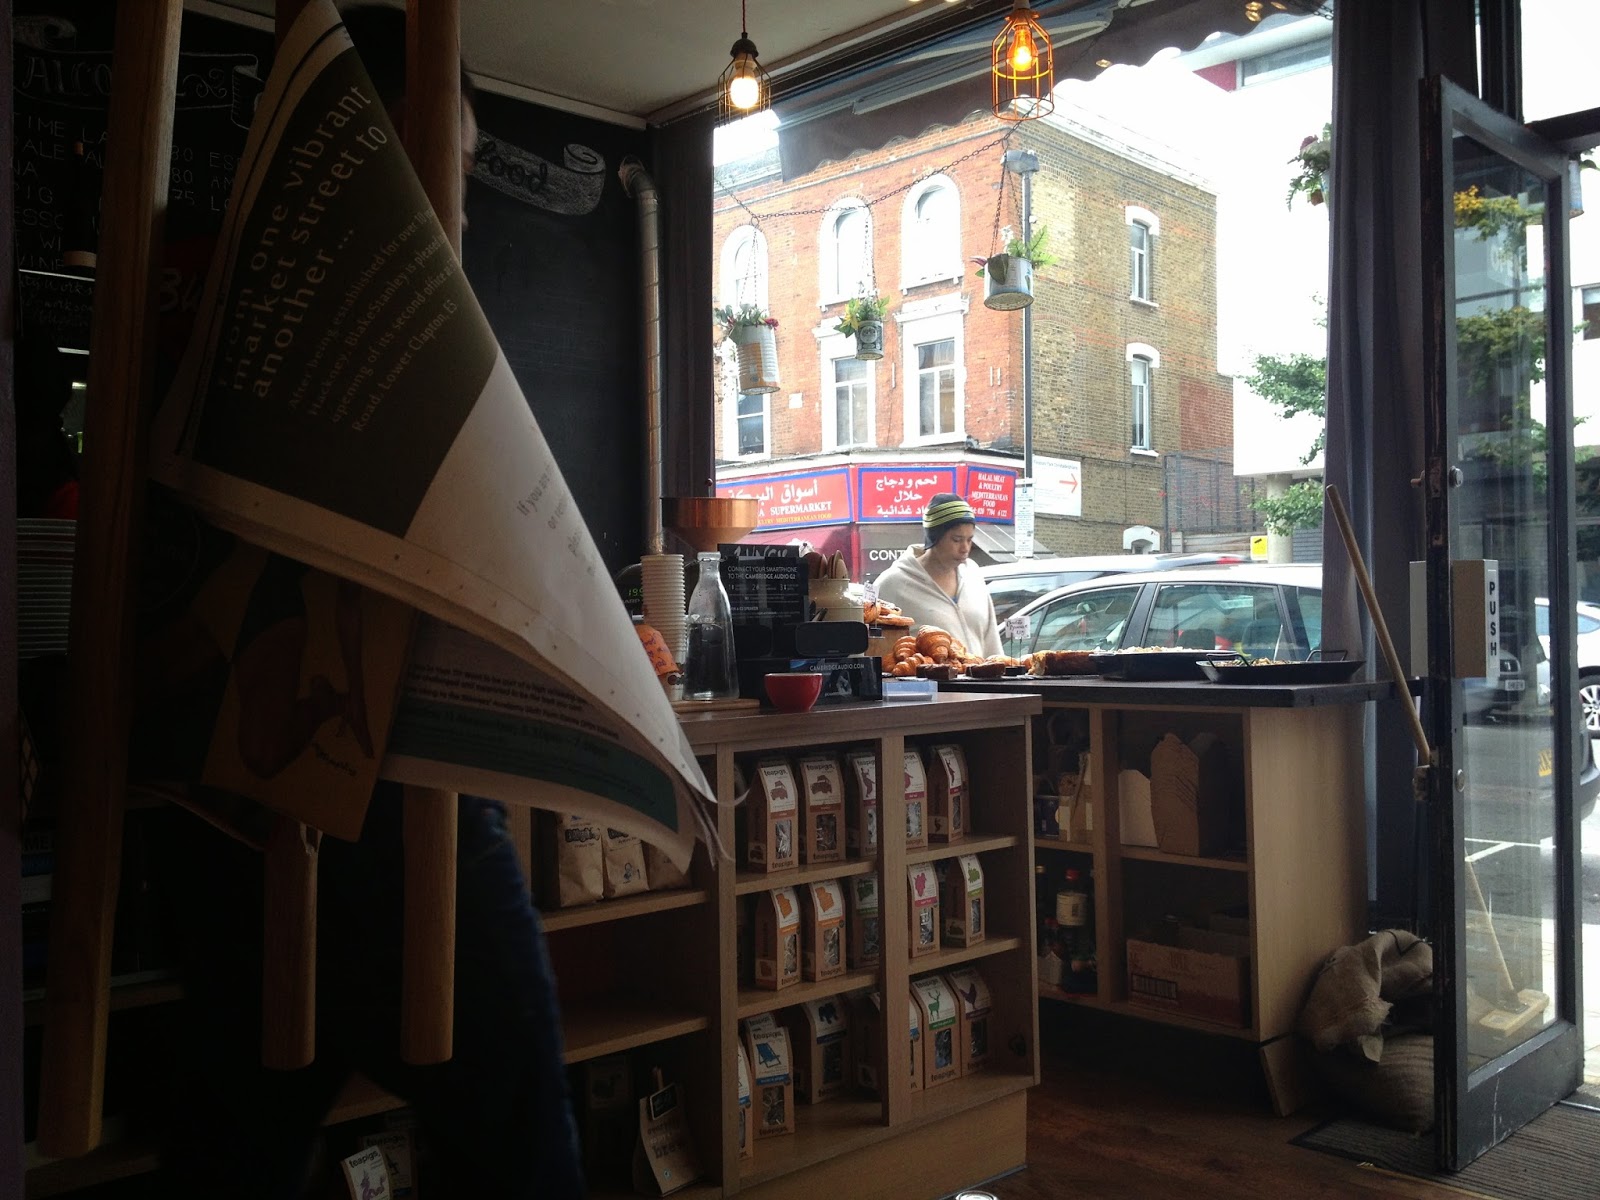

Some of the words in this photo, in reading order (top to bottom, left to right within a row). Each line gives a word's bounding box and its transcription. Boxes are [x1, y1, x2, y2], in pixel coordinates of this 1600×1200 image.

[251, 204, 289, 271] one
[283, 86, 371, 189] vibrant
[380, 238, 400, 257] for
[398, 221, 417, 242] over
[233, 256, 297, 391] market
[291, 150, 364, 245] street
[356, 126, 387, 151] to
[405, 262, 417, 277] is
[333, 366, 375, 423] opening
[367, 345, 380, 363] of
[378, 331, 395, 348] its
[391, 291, 427, 330] second
[423, 273, 447, 297] office
[378, 351, 412, 392] Lower
[978, 473, 993, 482] HALAL
[993, 475, 1005, 483] MEAT
[983, 483, 1002, 492] POULTRY
[894, 490, 922, 503] حلال
[972, 491, 1008, 501] MEDITERRANEAN
[770, 501, 832, 516] SUPERMARKET
[983, 500, 996, 508] FOOD
[728, 565, 751, 573] CONNECT
[766, 566, 798, 574] SMARTPHONE
[1489, 581, 1497, 656] PUSH
